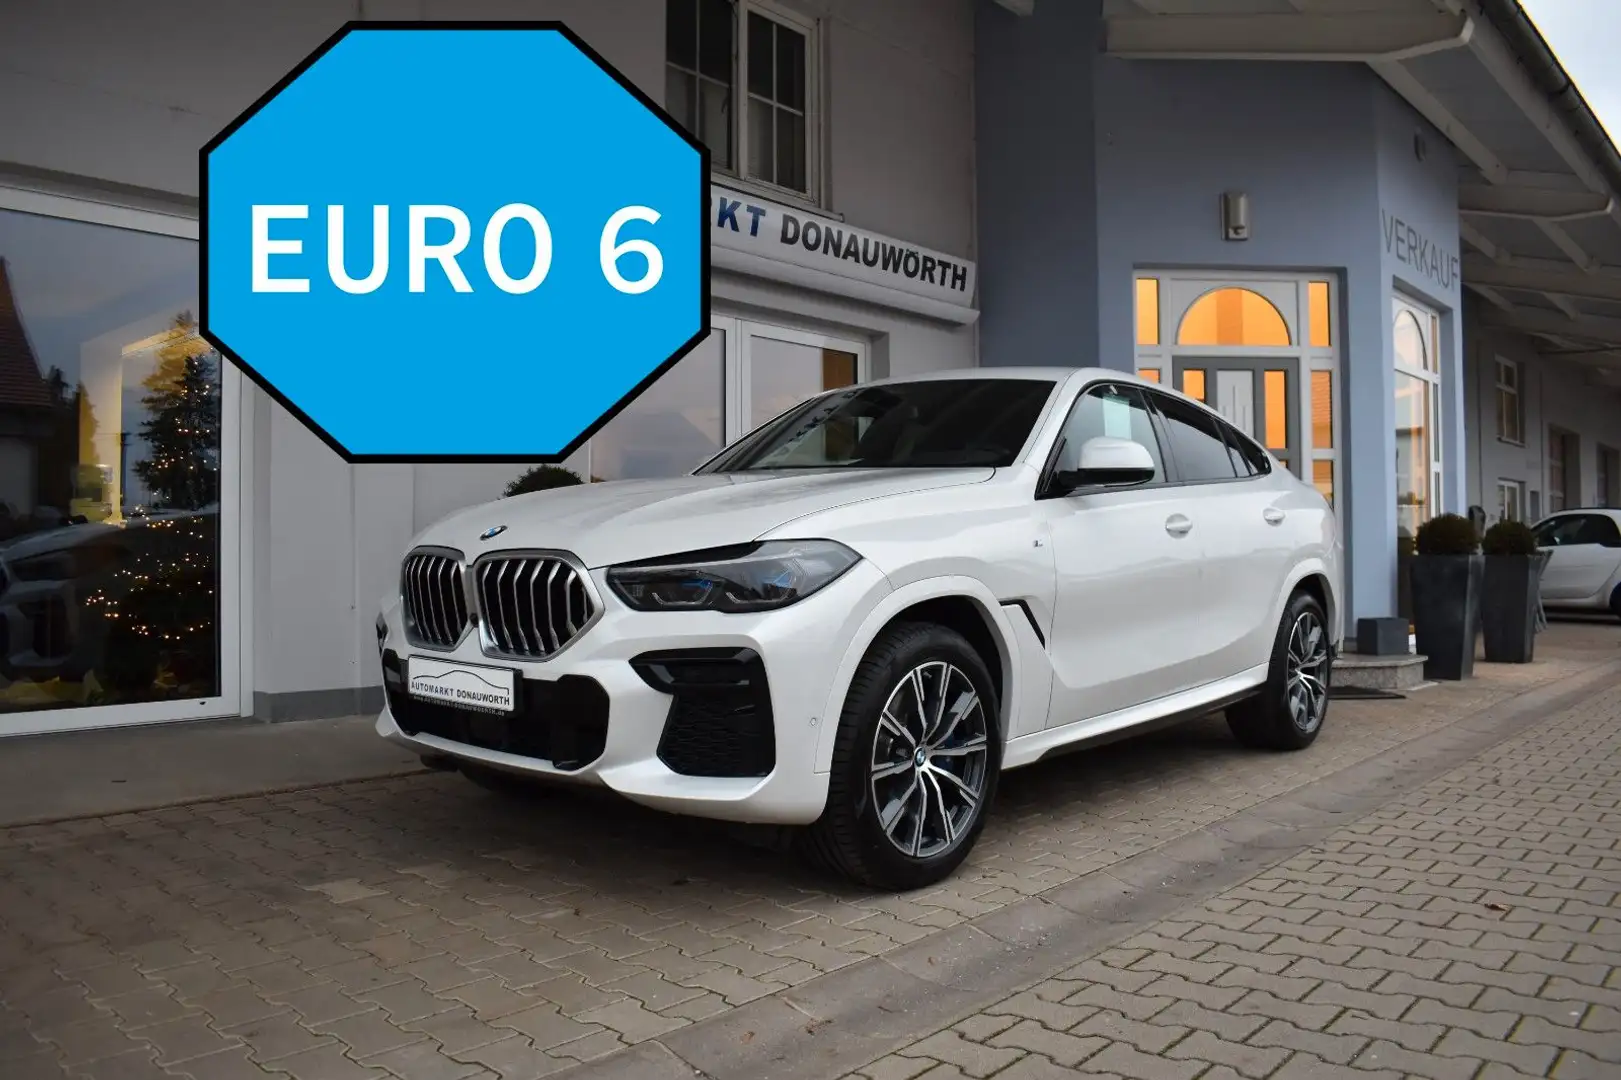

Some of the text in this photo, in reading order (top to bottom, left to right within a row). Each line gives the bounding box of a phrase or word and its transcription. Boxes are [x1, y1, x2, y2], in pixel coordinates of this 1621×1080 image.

[780, 213, 967, 292] DONAUWÖRTH
[1381, 207, 1459, 292] VERKAUF
[411, 681, 453, 697] AUTOMARKT
